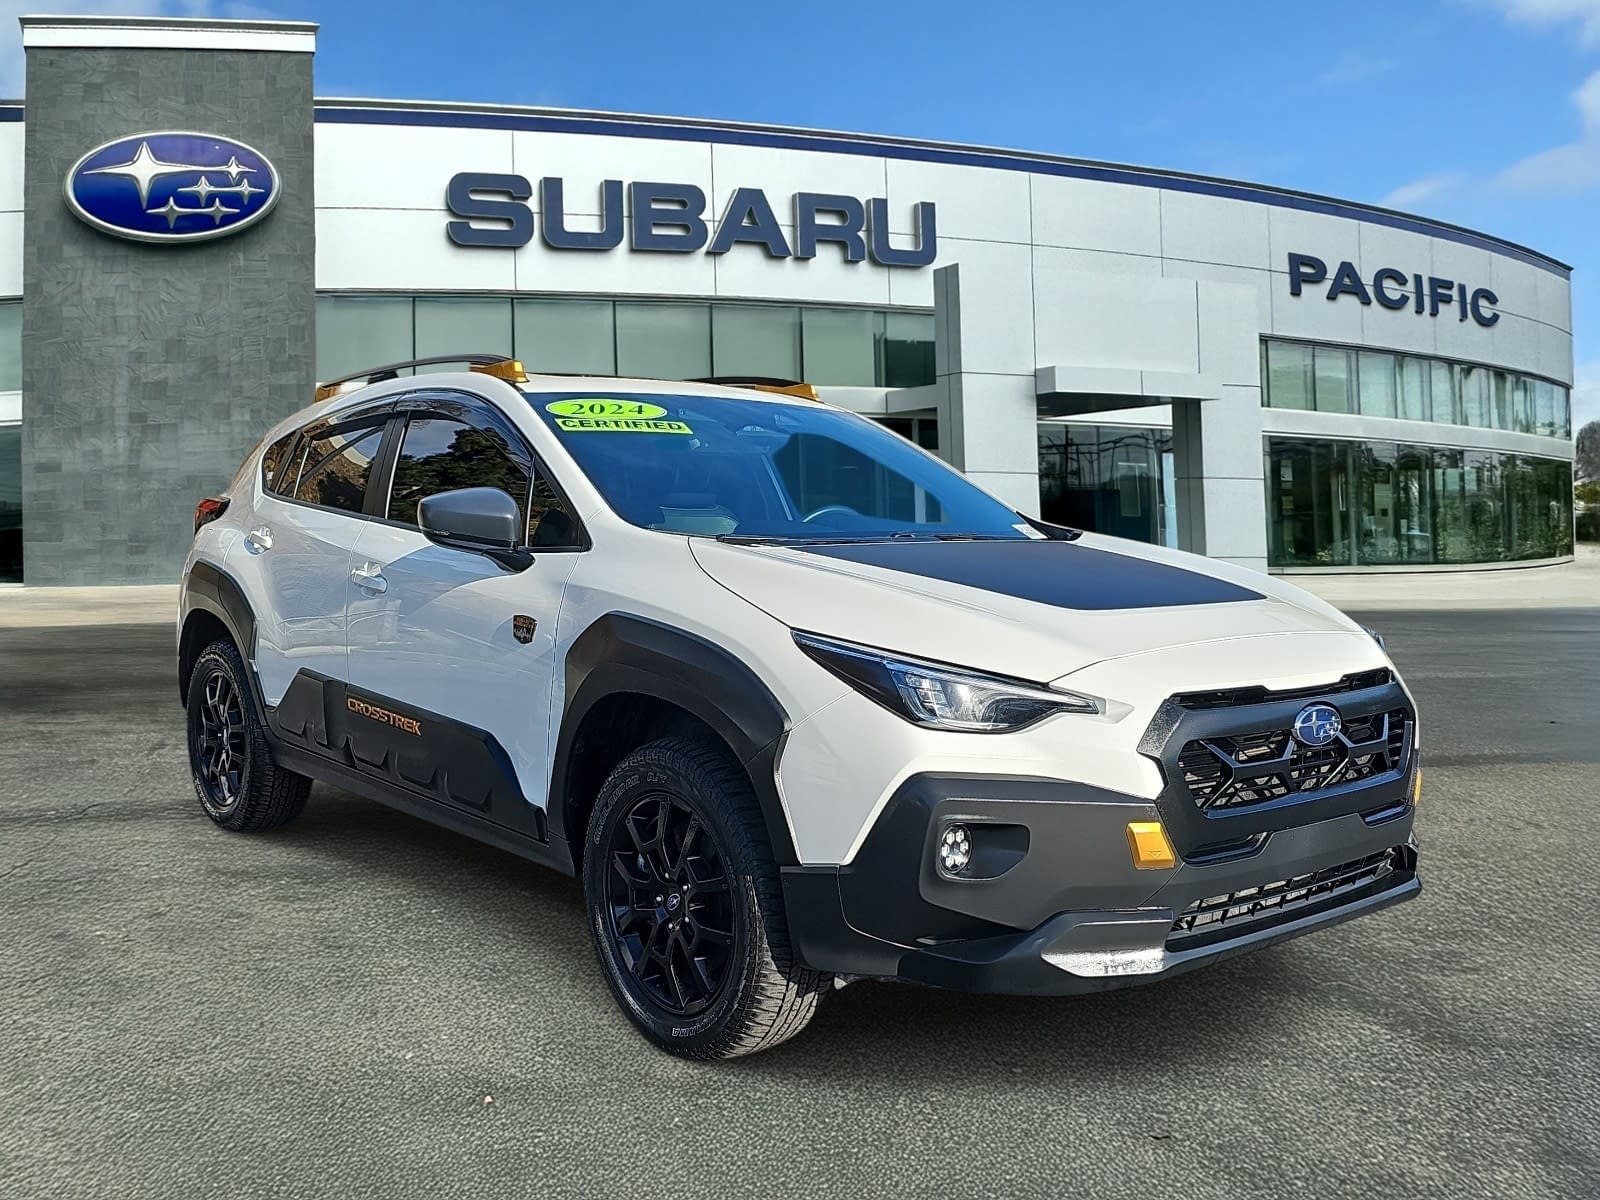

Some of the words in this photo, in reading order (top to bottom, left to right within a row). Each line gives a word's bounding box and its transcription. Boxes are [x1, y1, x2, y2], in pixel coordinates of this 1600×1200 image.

[447, 172, 937, 268] SUBARU
[1287, 252, 1501, 327] PACIFIC
[561, 418, 683, 431] CERTIFIED
[570, 403, 646, 415] 2024
[347, 698, 422, 736] CROSSTREK
